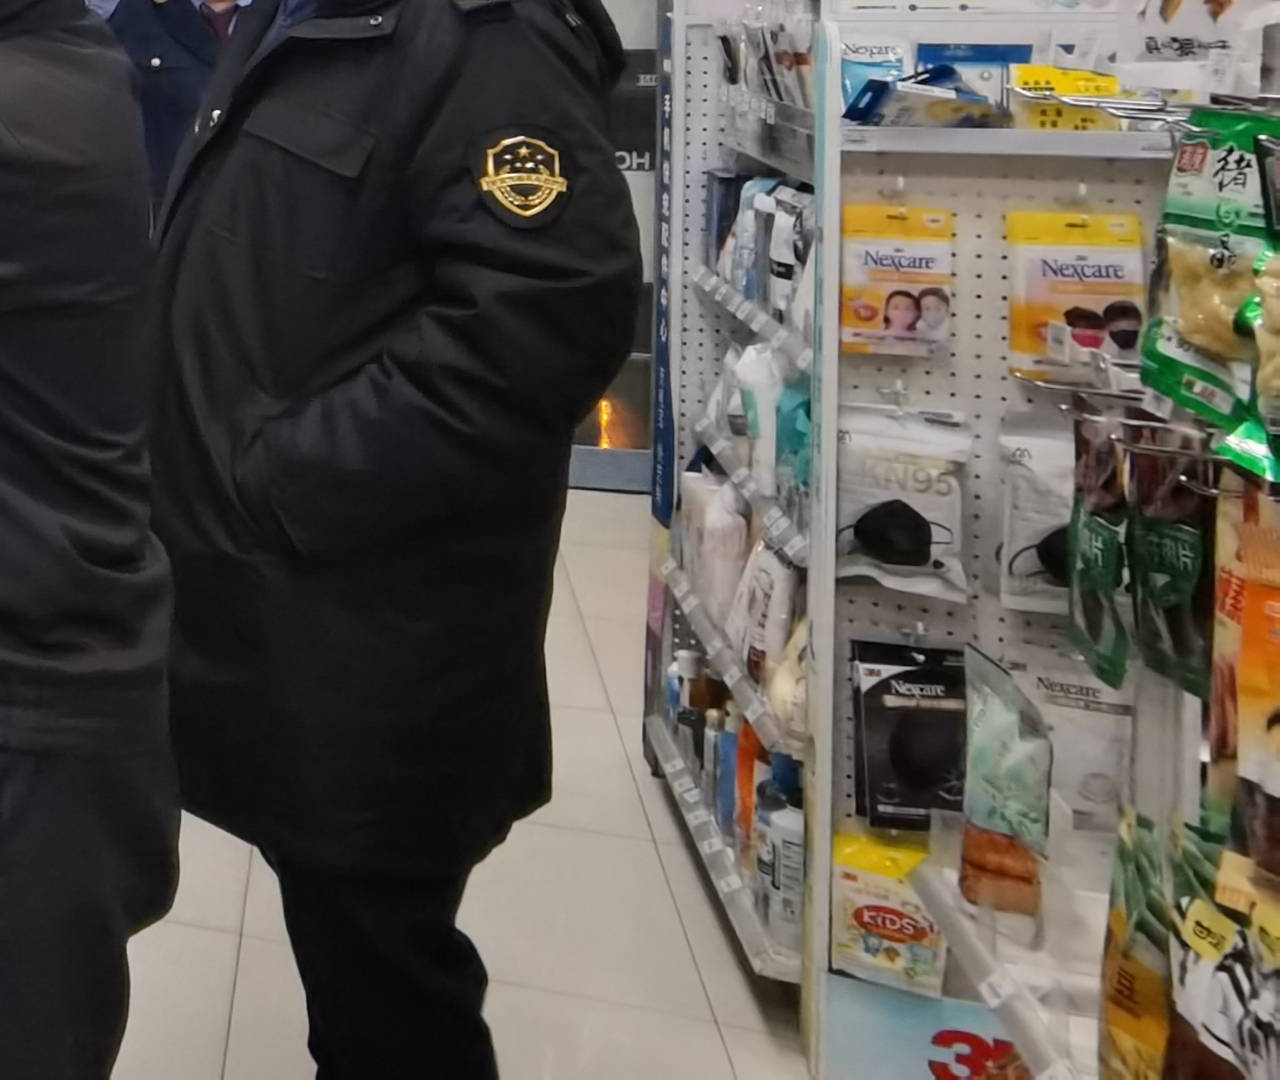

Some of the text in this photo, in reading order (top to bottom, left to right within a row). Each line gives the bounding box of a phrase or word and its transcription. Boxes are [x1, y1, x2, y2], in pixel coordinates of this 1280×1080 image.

[863, 249, 936, 272] Nexcare
[1041, 257, 1126, 282] Nexcare
[889, 678, 946, 698] Nexcare
[1037, 676, 1102, 700] Nexcare
